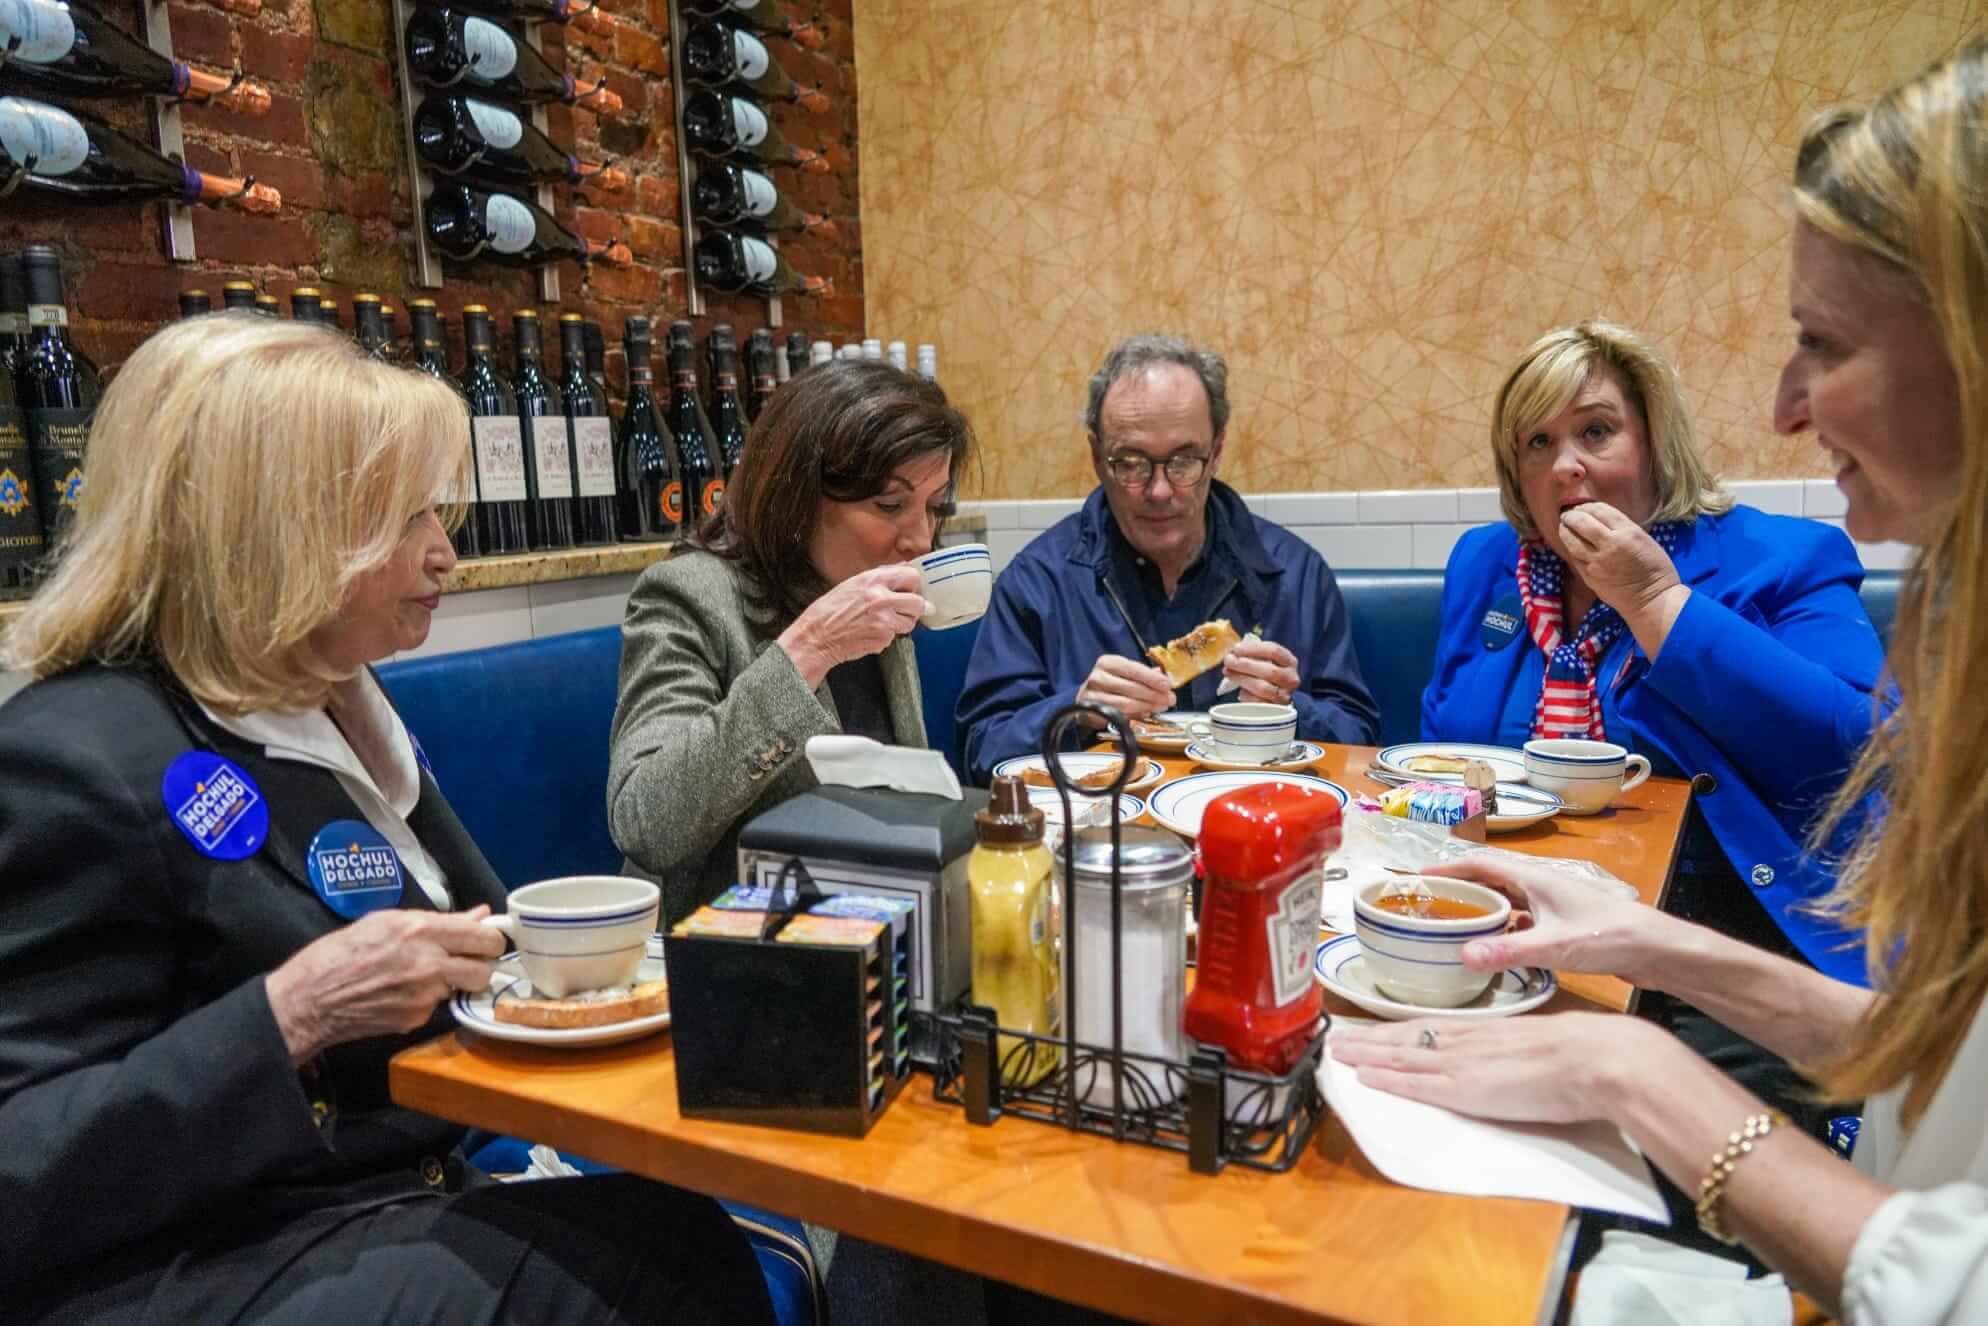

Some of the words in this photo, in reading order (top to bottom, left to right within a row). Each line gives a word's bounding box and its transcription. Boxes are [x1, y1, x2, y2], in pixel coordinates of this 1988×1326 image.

[183, 773, 235, 826] HOCHUL
[194, 783, 245, 837] DELGADO
[322, 851, 393, 870] HOCHUL
[326, 865, 396, 883] DELGADO
